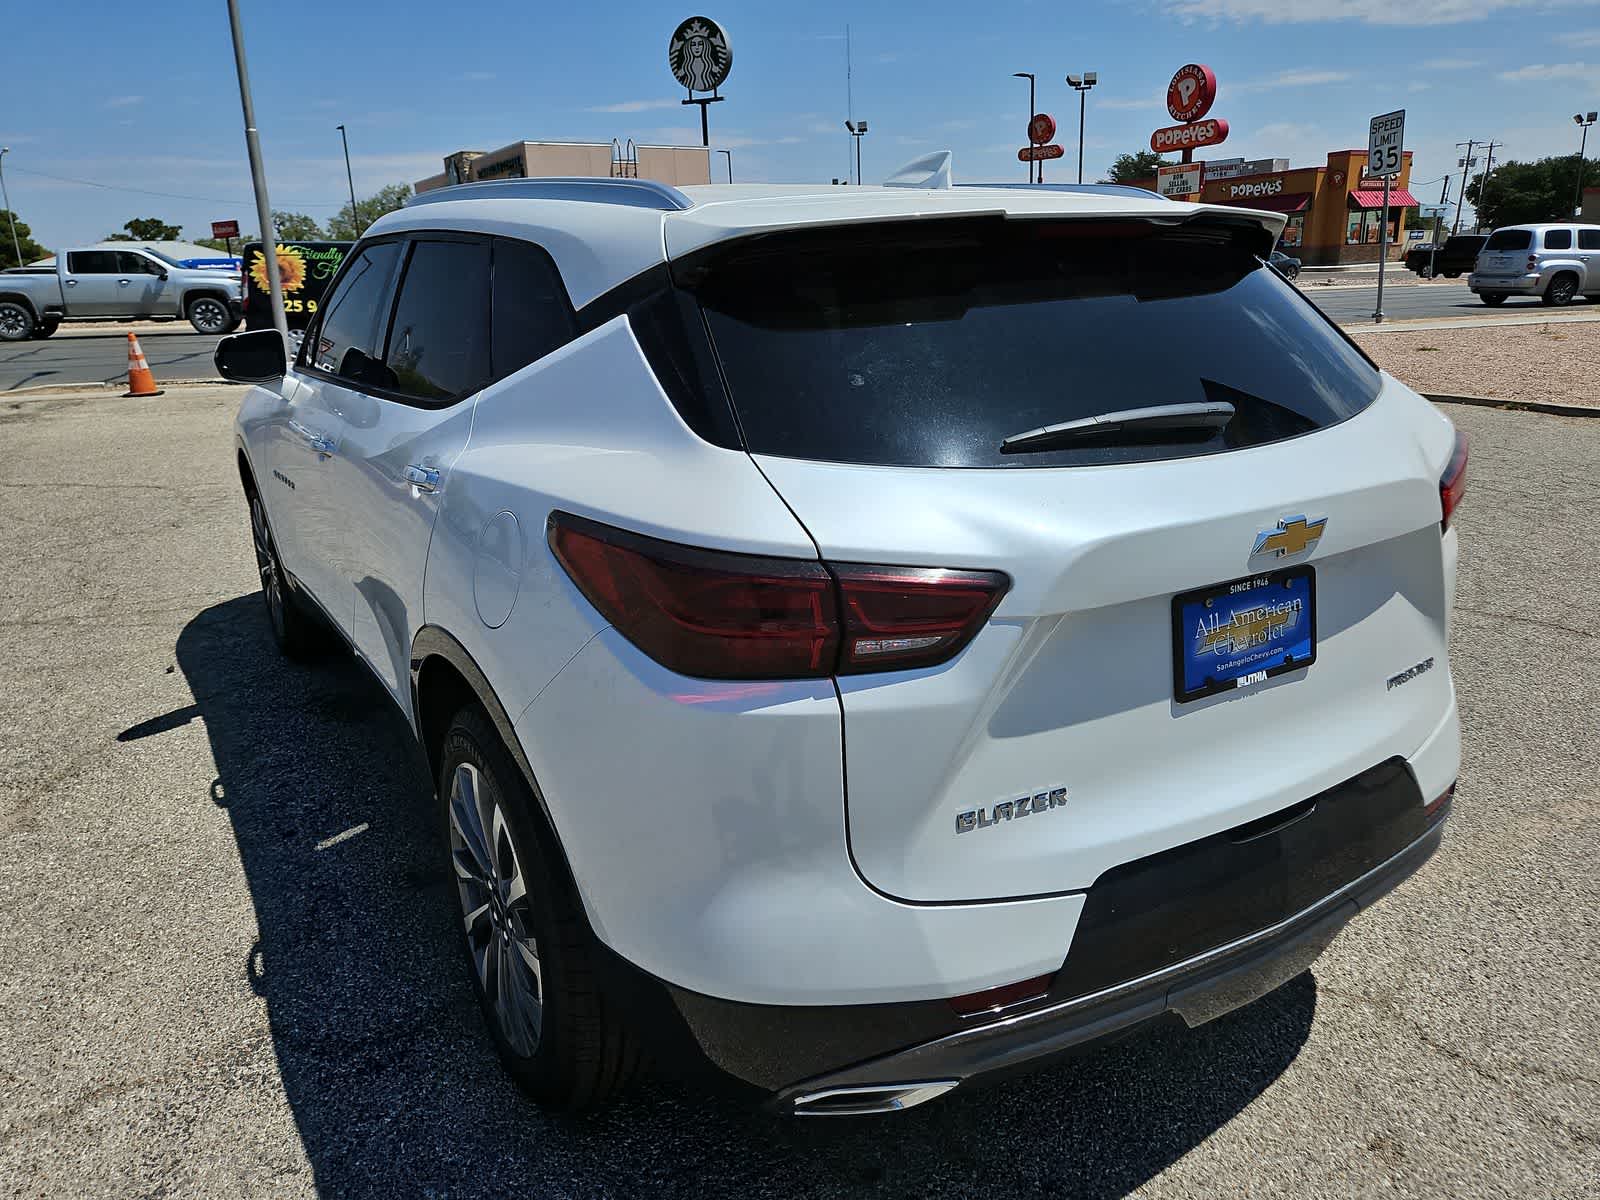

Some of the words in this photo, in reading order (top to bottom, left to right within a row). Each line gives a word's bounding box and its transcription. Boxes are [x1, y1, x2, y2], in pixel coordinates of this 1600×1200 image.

[1169, 65, 1205, 93] LOUISIANA
[1169, 99, 1202, 119] KITCHEN
[1156, 121, 1214, 147] POPEYES
[1371, 117, 1402, 134] SPEED
[1374, 132, 1398, 147] LIMIT
[1372, 146, 1397, 171] 35
[1231, 180, 1282, 197] POPEYES
[289, 245, 343, 267] Friendly
[1230, 581, 1251, 594] SINCE
[1253, 578, 1269, 588] 1946
[1195, 612, 1219, 639] All
[1227, 598, 1303, 627] American
[1213, 621, 1285, 656] Chevrolet
[1216, 647, 1284, 672] SanAngeloChevy.com
[955, 787, 1068, 834] BLAZER
